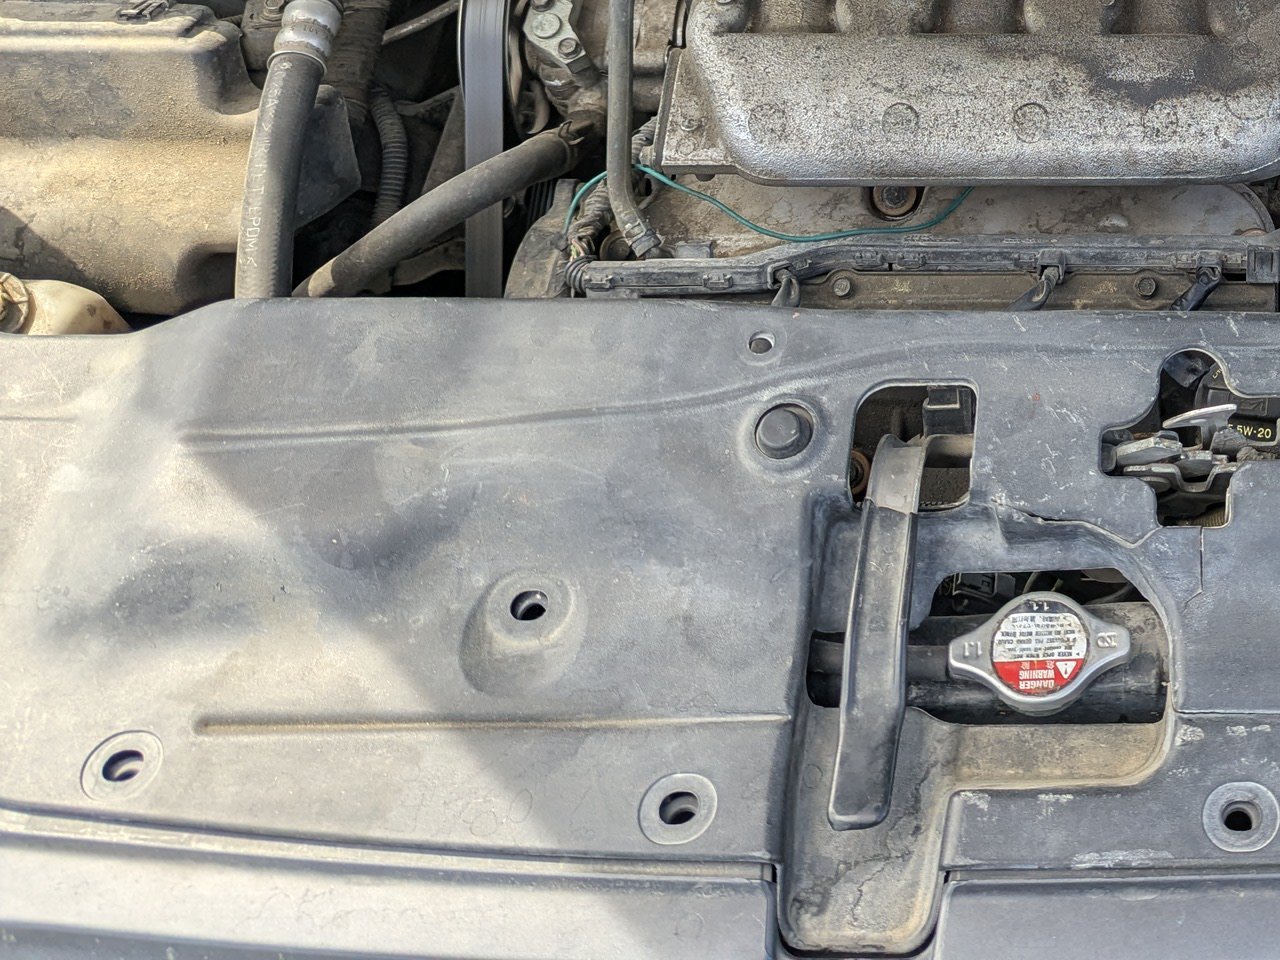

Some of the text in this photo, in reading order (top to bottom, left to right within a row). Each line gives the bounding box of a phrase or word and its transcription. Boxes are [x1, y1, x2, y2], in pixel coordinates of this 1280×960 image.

[1237, 424, 1271, 438] 5W-20
[1019, 670, 1054, 679] WARNING
[1019, 680, 1054, 689] DANGER
